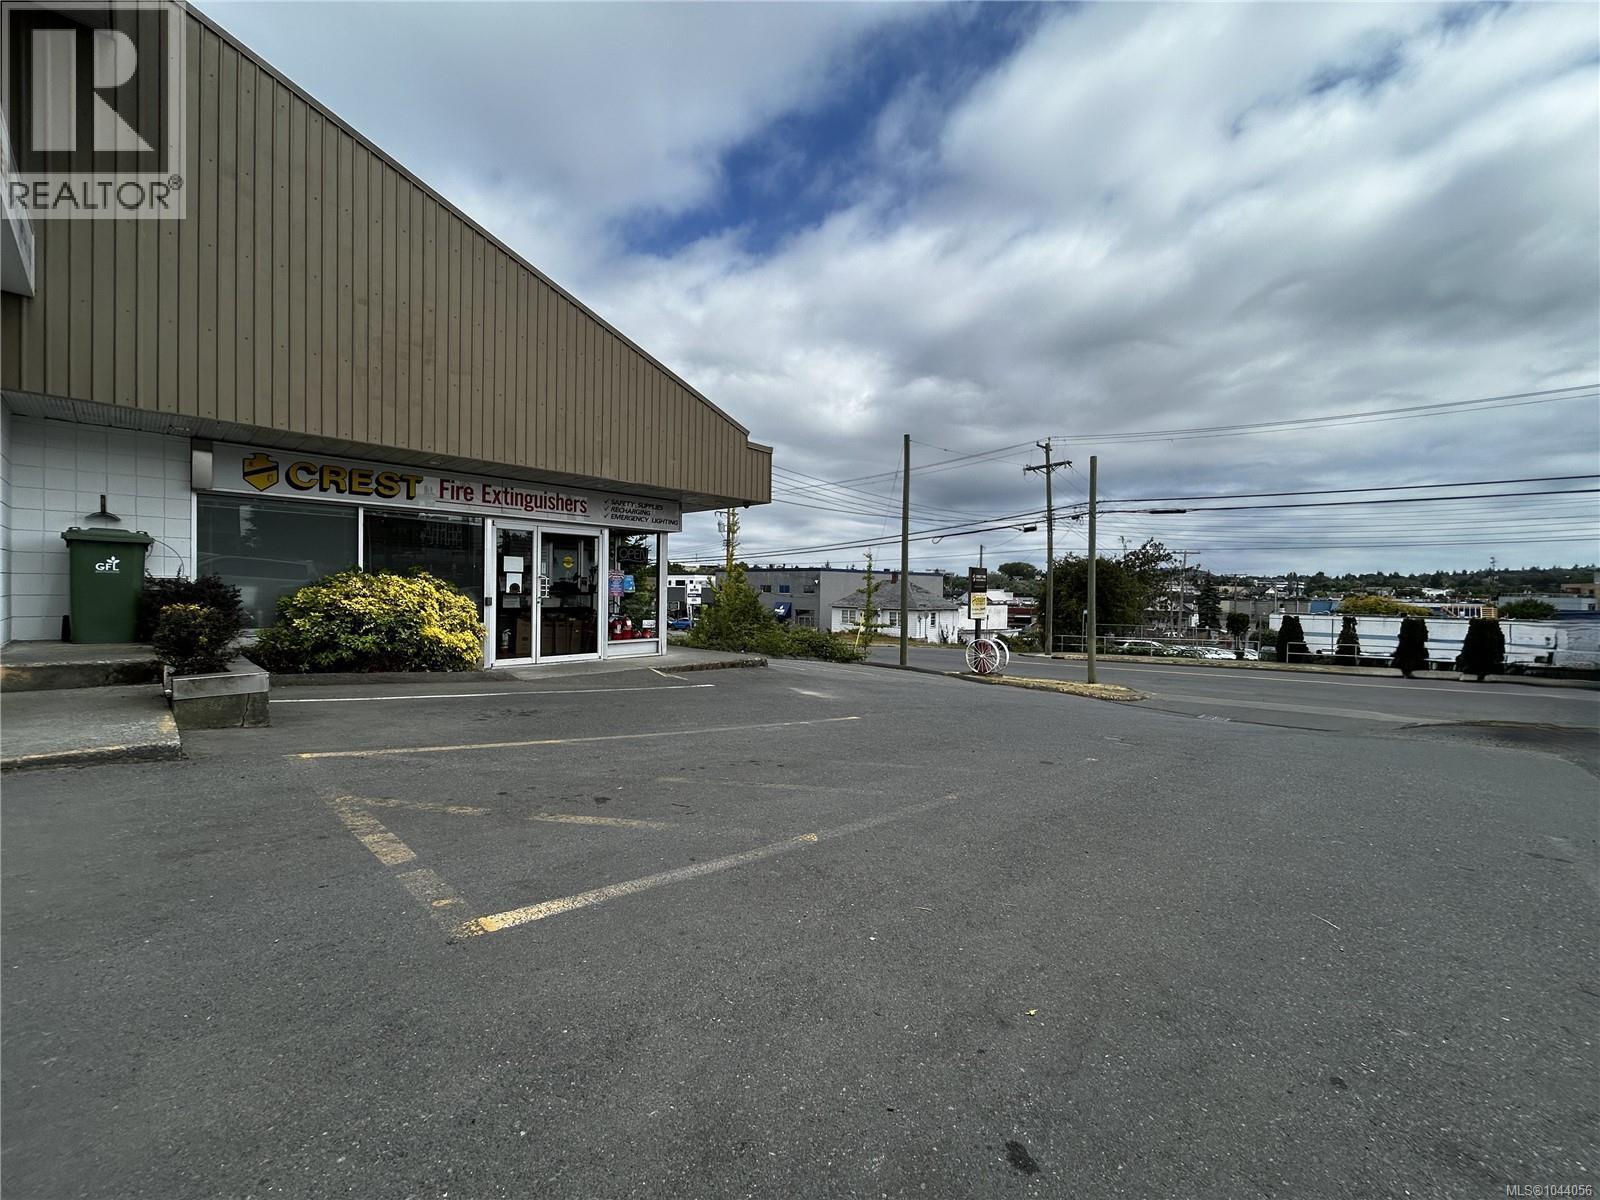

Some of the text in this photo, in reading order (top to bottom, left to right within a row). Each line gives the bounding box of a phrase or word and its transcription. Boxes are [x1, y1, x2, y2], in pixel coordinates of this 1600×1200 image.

[285, 461, 424, 500] CREST
[439, 478, 475, 502] Fire
[481, 483, 588, 514] Extinguishers
[610, 506, 651, 516] RECHARGING
[610, 514, 650, 522] EMERGENCY
[619, 547, 647, 560] OPEN
[95, 557, 120, 571] GFL
